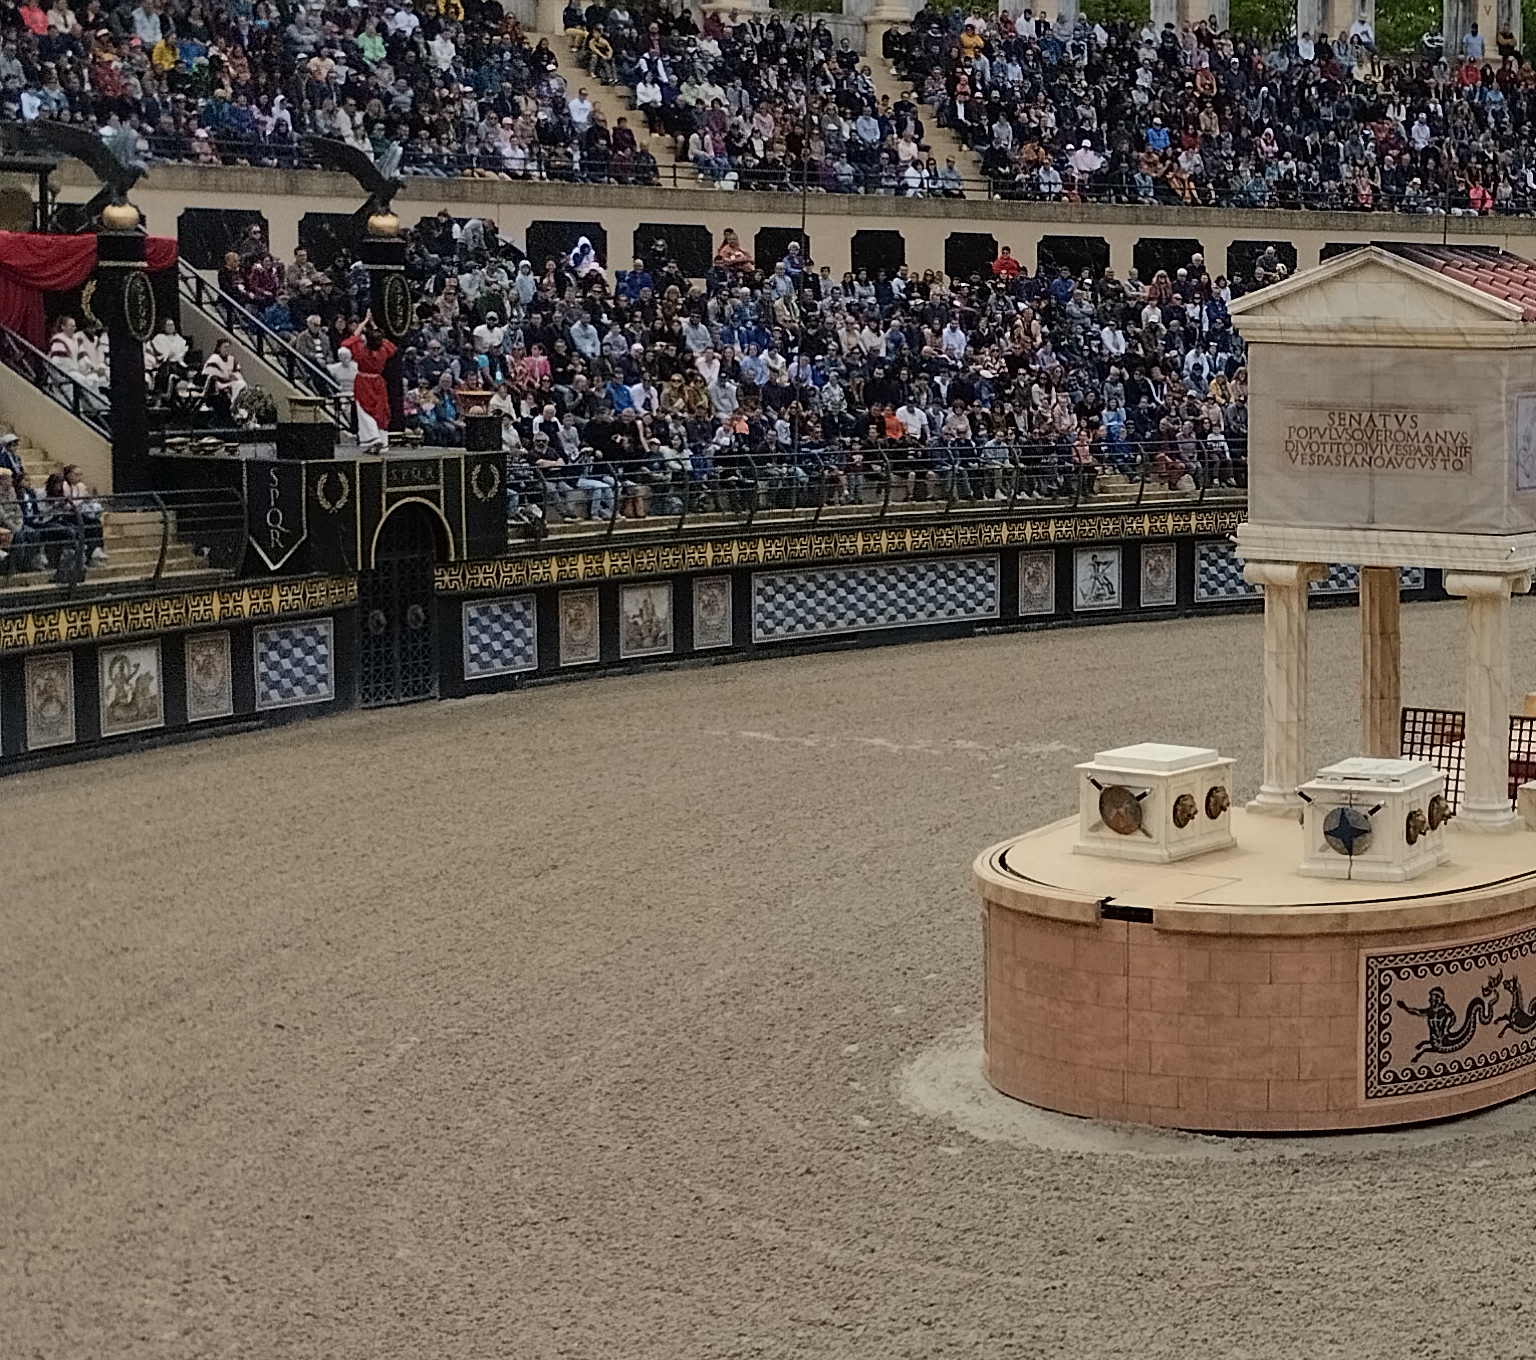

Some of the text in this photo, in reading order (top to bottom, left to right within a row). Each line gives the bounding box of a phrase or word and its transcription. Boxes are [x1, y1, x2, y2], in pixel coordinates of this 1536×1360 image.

[1483, 4, 1492, 15] V
[1328, 412, 1418, 429] SENATVS
[267, 468, 291, 548] SPQR
